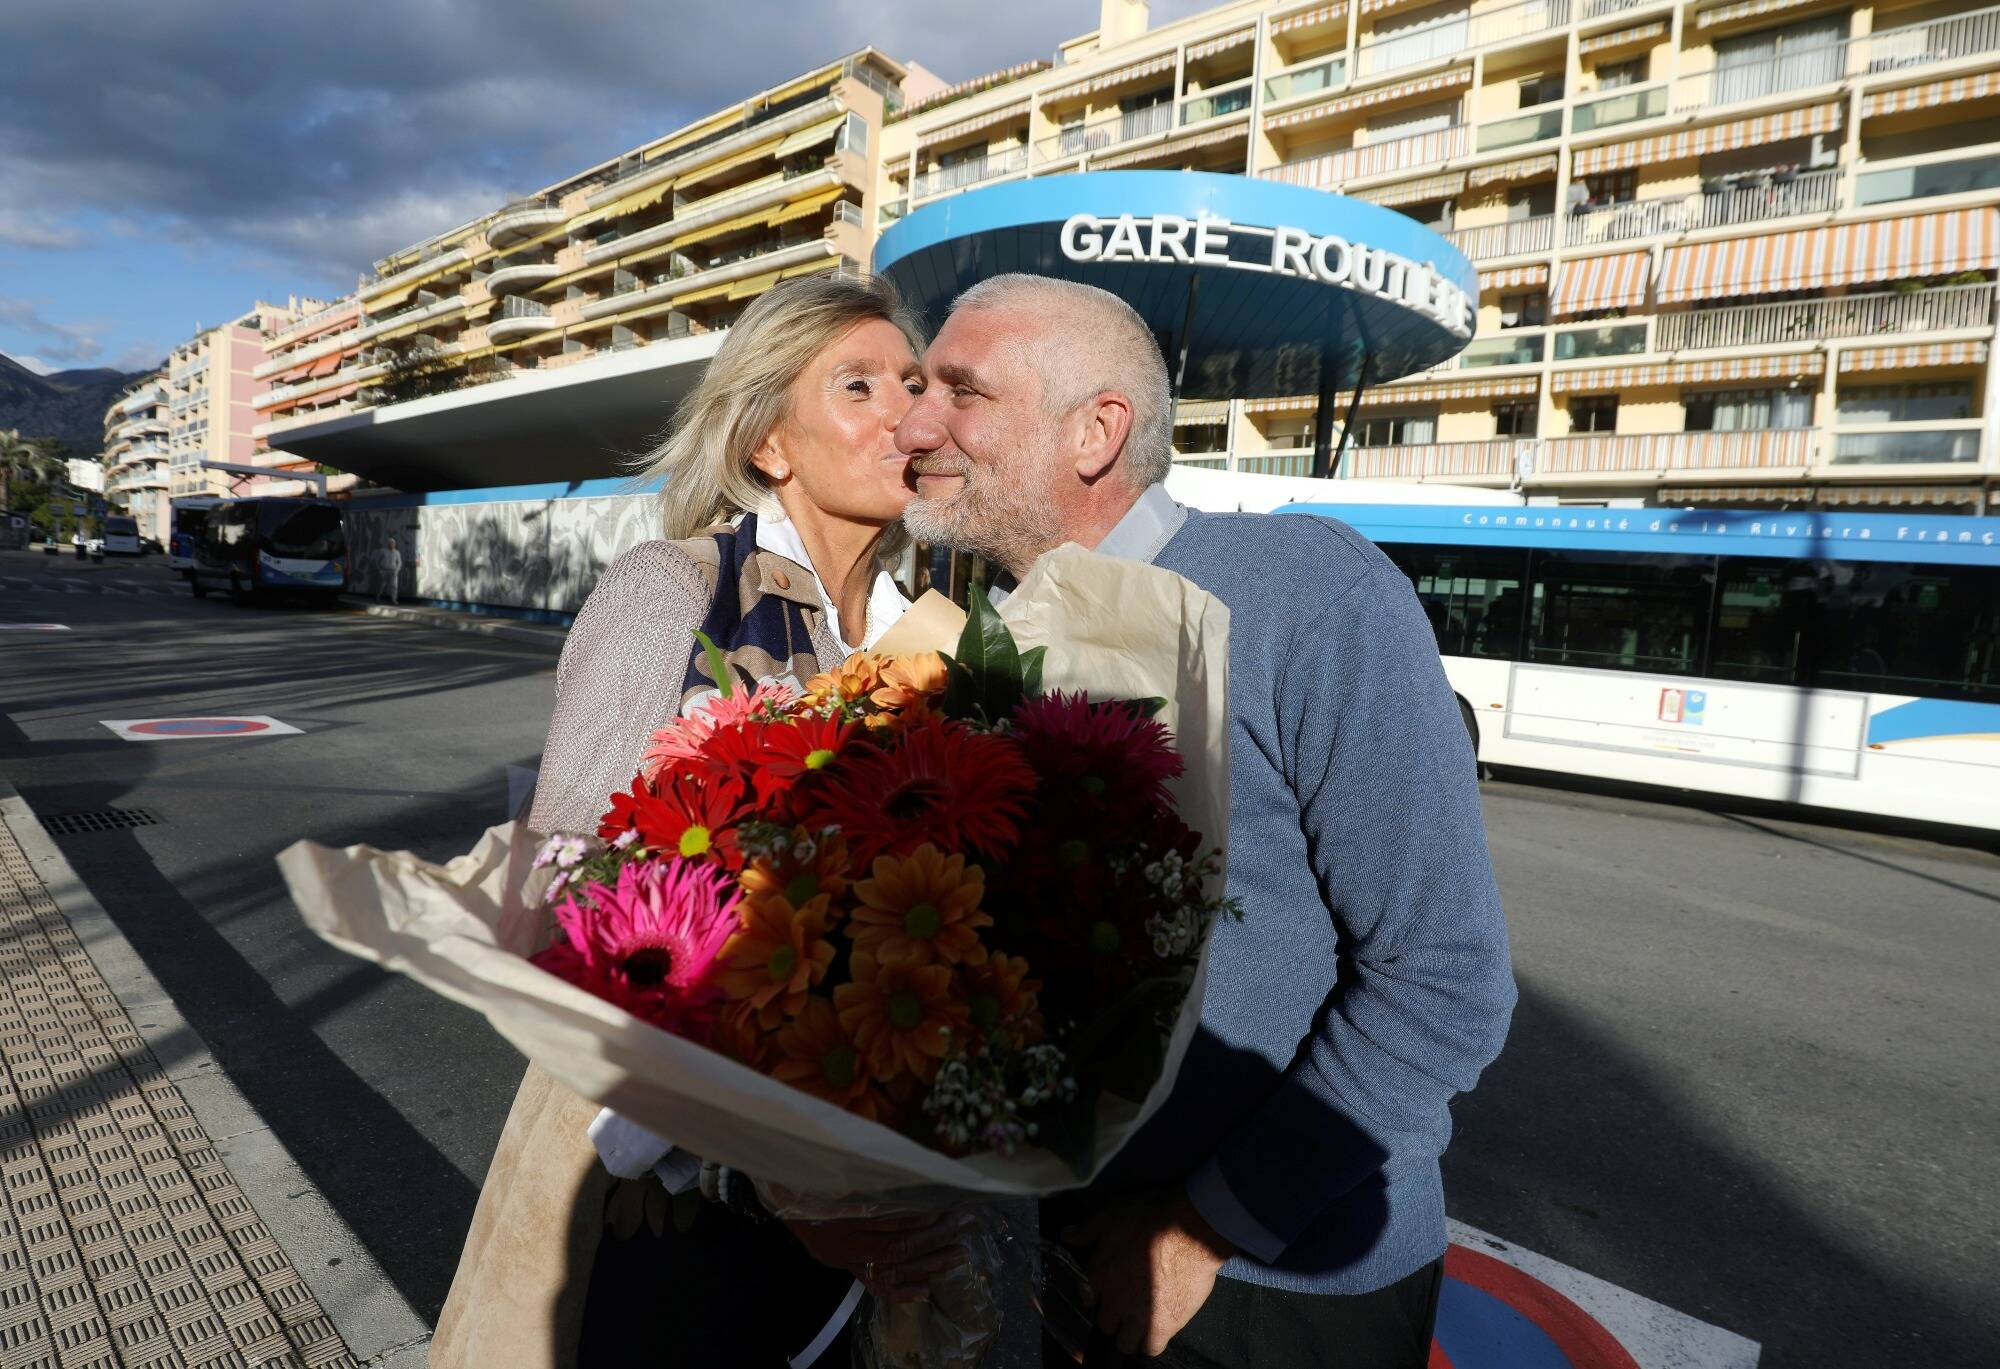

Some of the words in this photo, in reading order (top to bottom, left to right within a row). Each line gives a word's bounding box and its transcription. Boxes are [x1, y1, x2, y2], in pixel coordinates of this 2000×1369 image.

[1060, 213, 1230, 266] GARE
[1463, 513, 1629, 531] Communauté
[1649, 518, 1680, 533] de
[1702, 520, 1727, 534] la
[1750, 522, 1871, 539] Riviera
